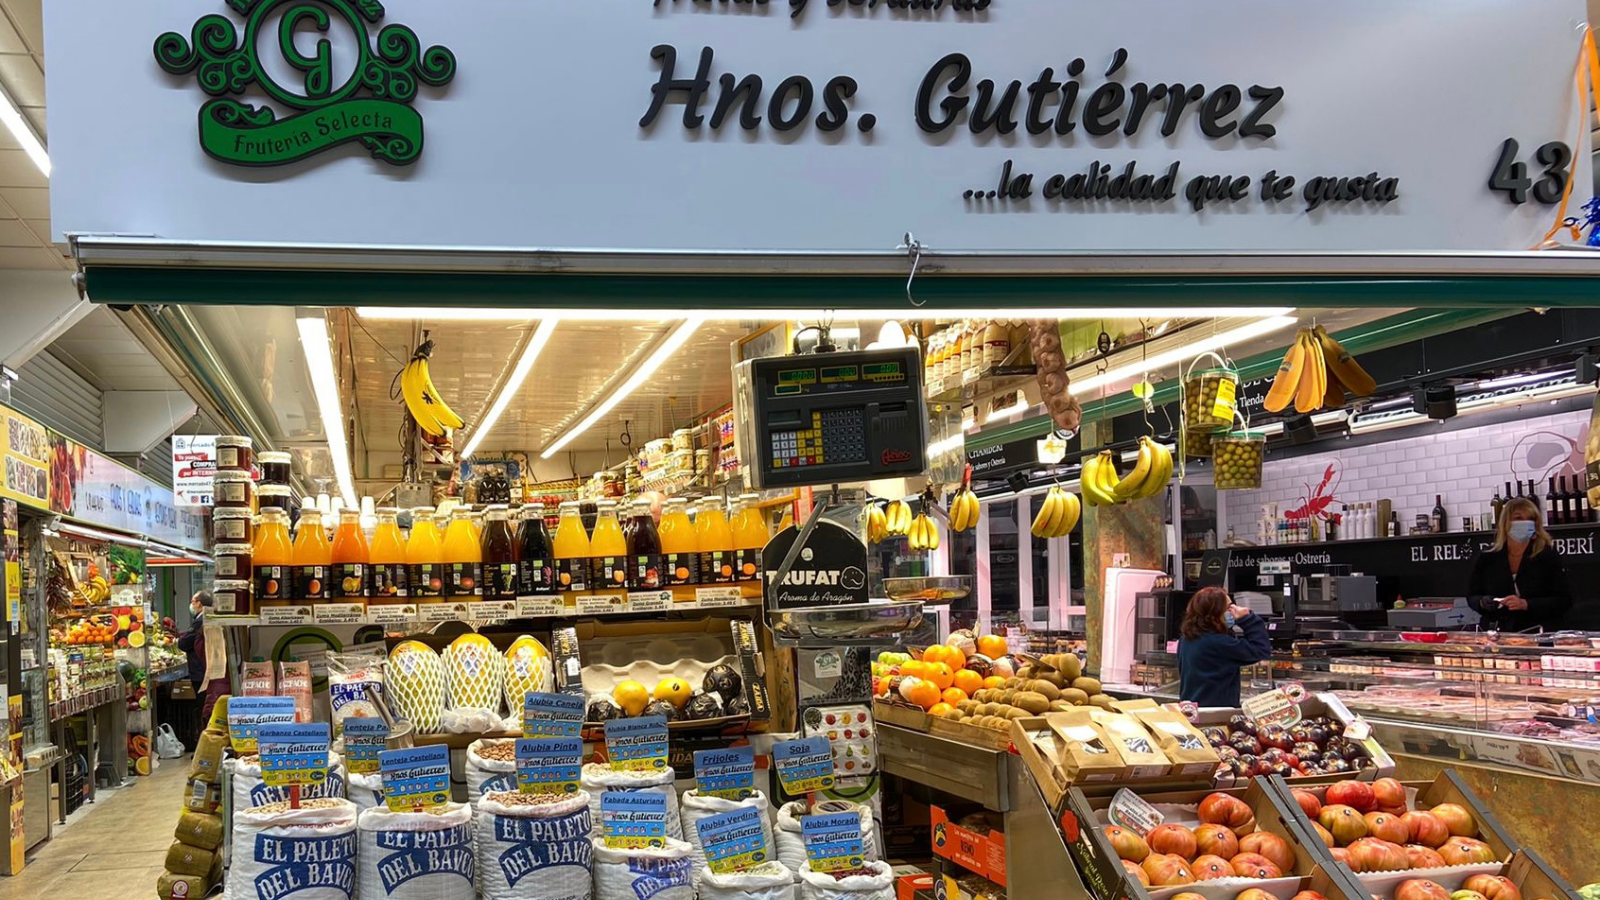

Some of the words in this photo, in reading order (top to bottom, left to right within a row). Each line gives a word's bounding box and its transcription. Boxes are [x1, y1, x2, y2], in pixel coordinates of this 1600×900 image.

[638, 44, 877, 133] Hnos.
[914, 48, 1284, 138] Gutiérrez
[315, 111, 392, 137] Selecta
[1487, 137, 1574, 206] 43
[1043, 160, 1180, 202] calidad
[1186, 172, 1249, 212] que
[1260, 168, 1295, 200] te
[1302, 169, 1400, 212] gusta
[1239, 392, 1264, 408] Tienda
[1244, 554, 1257, 567] de
[1294, 550, 1331, 566] Ostrería
[1410, 545, 1428, 562] EL
[765, 570, 841, 586] TRUFAT
[779, 591, 808, 602] Aroma
[809, 591, 820, 601] de
[821, 591, 854, 604] Aragón
[334, 684, 345, 693] EL
[333, 694, 351, 709] DEL
[527, 697, 554, 706] Alubia
[555, 700, 583, 709] Canela
[259, 729, 292, 737] Garbanzo
[293, 729, 328, 737] Castellano
[344, 723, 375, 731] Lenteja
[520, 743, 551, 754] Alubia
[552, 742, 578, 752] Pinta
[789, 743, 811, 756] Soja
[381, 756, 408, 767] Lenteja
[409, 752, 446, 763] Castellana
[702, 752, 740, 766] Frijoles
[603, 796, 630, 804] Fabada
[631, 796, 665, 805] Asturiana
[502, 818, 527, 841] EL
[530, 809, 592, 842] PALETO
[699, 820, 725, 832] Alubia
[726, 811, 758, 825] Verdina
[804, 819, 829, 830] Alubia
[829, 816, 859, 827] Morada
[383, 831, 408, 848] EL
[413, 823, 473, 849] PALETO
[262, 838, 288, 862] EL
[293, 833, 356, 863] PALETO
[381, 852, 423, 887] DEL
[502, 845, 543, 879] DEL
[257, 867, 302, 900] DEL
